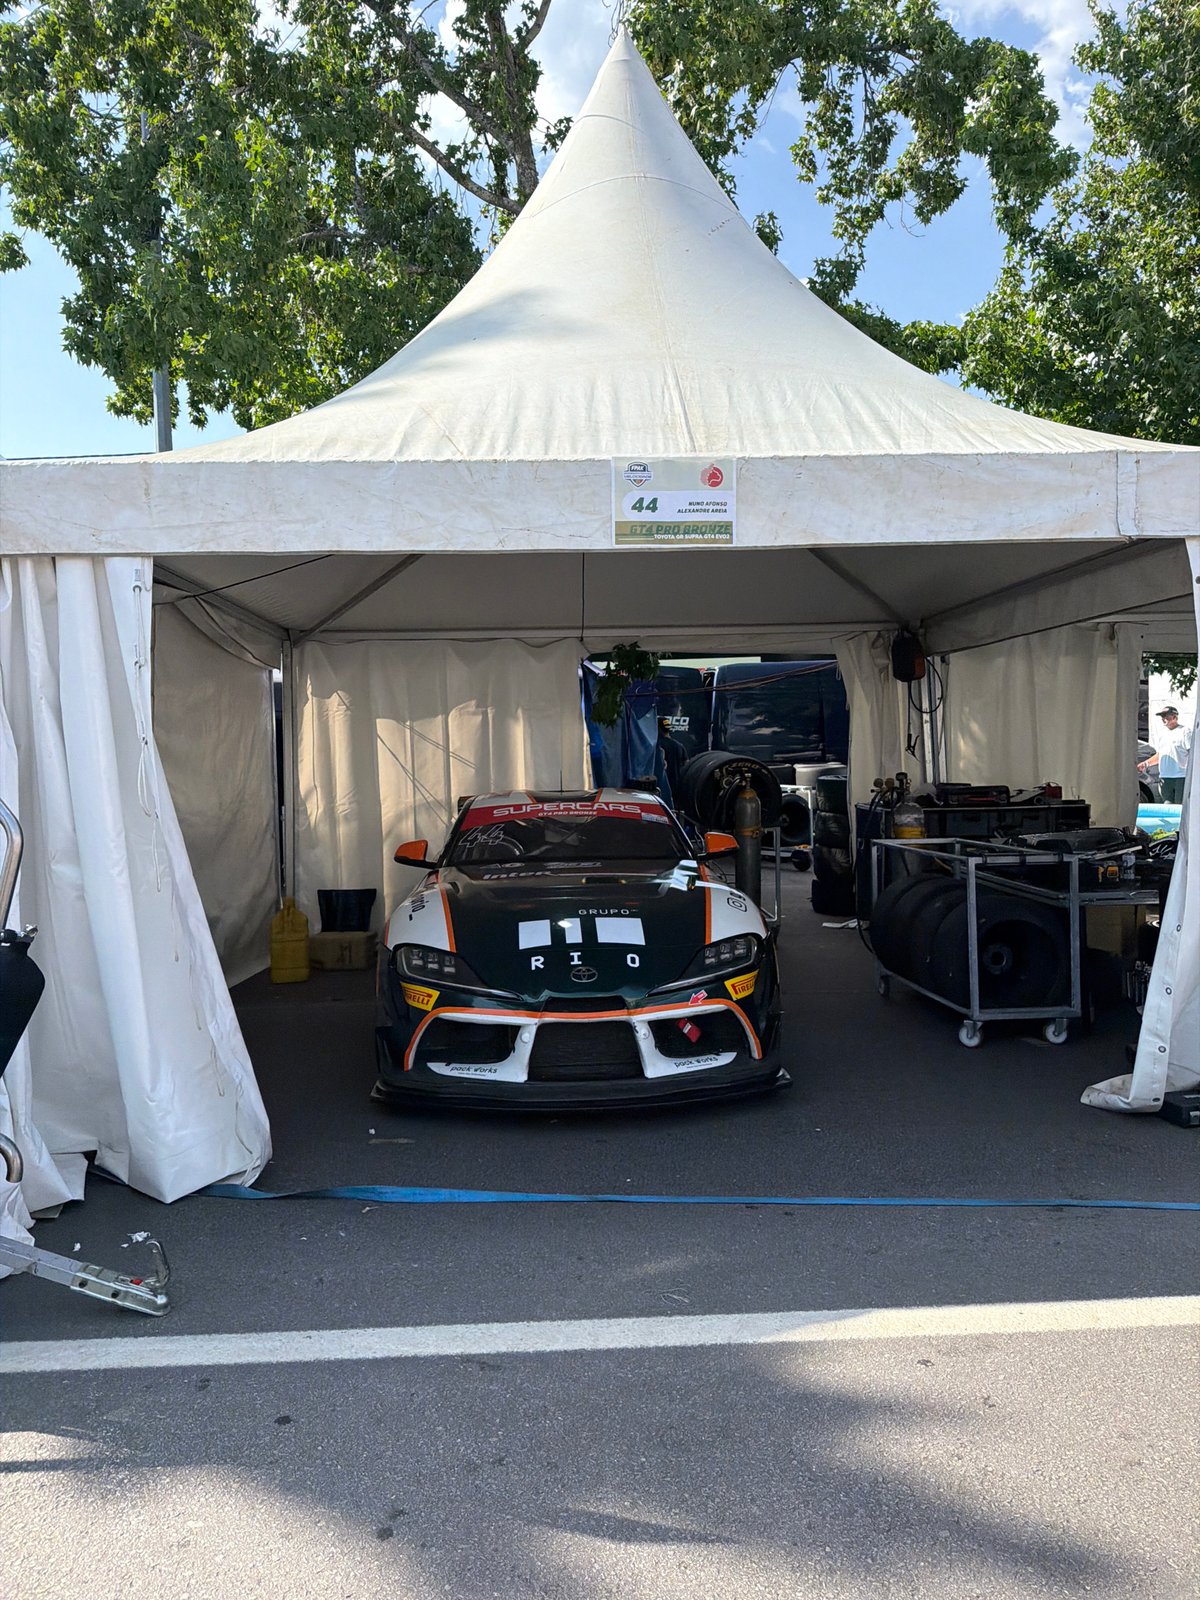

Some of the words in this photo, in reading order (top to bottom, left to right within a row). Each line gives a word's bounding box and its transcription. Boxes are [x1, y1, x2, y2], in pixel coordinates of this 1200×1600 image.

[631, 497, 659, 513] 44
[630, 525, 654, 535] GT4
[655, 525, 681, 534] PRO
[682, 524, 731, 534] BRONZE
[493, 802, 641, 817] SUPERCARS
[459, 823, 505, 848] 44
[578, 908, 630, 916] GRUPO
[450, 1065, 471, 1073] pack
